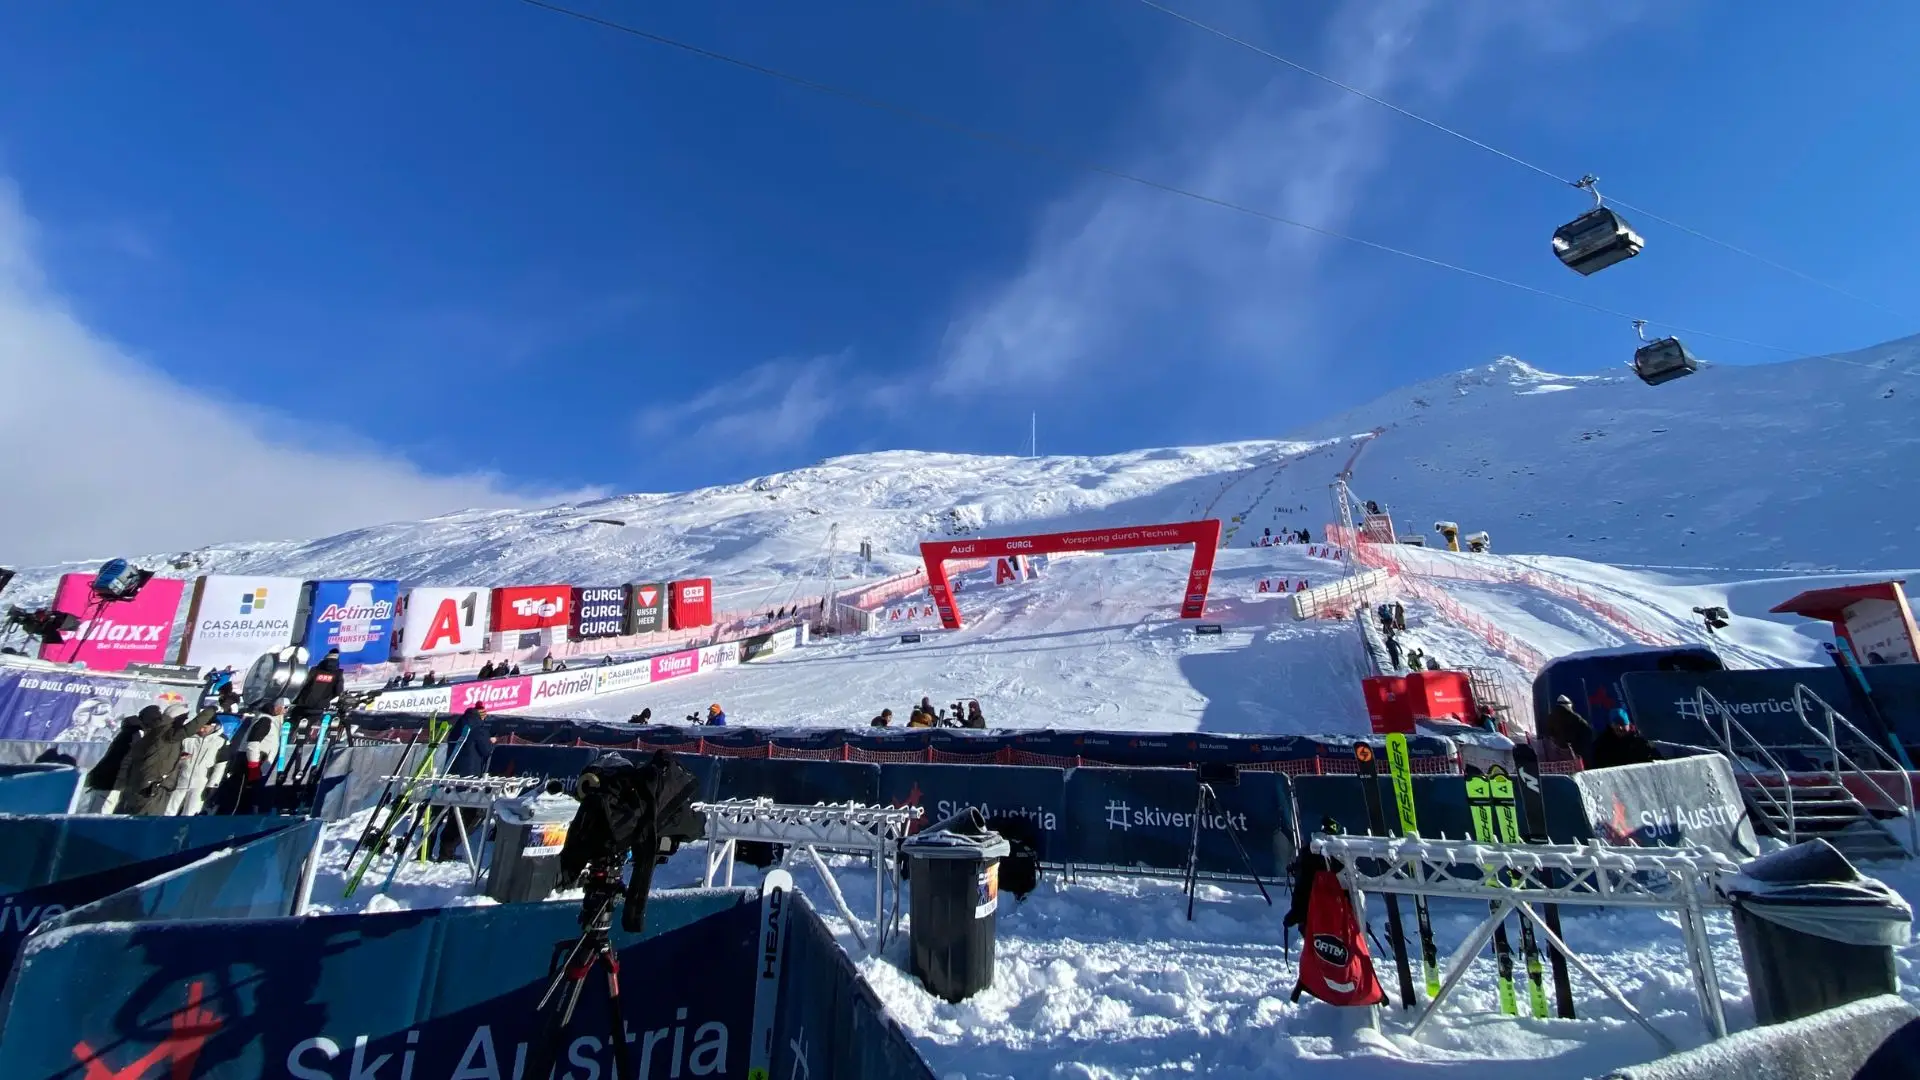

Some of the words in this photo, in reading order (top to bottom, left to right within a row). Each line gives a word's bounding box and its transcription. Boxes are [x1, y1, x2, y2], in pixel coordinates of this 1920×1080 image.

[1062, 534, 1110, 545] Vorsprung
[1112, 531, 1139, 541] durch
[1141, 529, 1179, 538] Technik
[951, 544, 975, 553] Audi
[1006, 541, 1033, 550] GURGL
[582, 589, 624, 602] GURGL
[319, 602, 391, 621] Actimel
[512, 596, 563, 617] Tirol
[581, 605, 622, 618] GURGL
[636, 608, 657, 616] UNSER
[202, 619, 289, 630] CASABLANCA
[420, 592, 477, 651] A1
[580, 621, 621, 634] GURGL
[638, 617, 655, 625] HEER
[200, 630, 289, 639] hotelsoftware
[658, 655, 692, 673] Stilaxx
[701, 645, 736, 667] Actimel
[608, 666, 650, 680] CASABLANCA
[18, 678, 38, 689] RED
[40, 681, 62, 692] BULL
[65, 683, 92, 694] GIVES
[94, 686, 113, 697] YOU
[534, 672, 592, 700] Actimel
[464, 683, 521, 706] Stilaxx
[377, 695, 448, 711] CASABLANCA
[1392, 741, 1414, 826] FISCHER
[1640, 807, 1673, 839] Ski
[1676, 802, 1741, 833] Austria
[763, 886, 783, 980] HEAD
